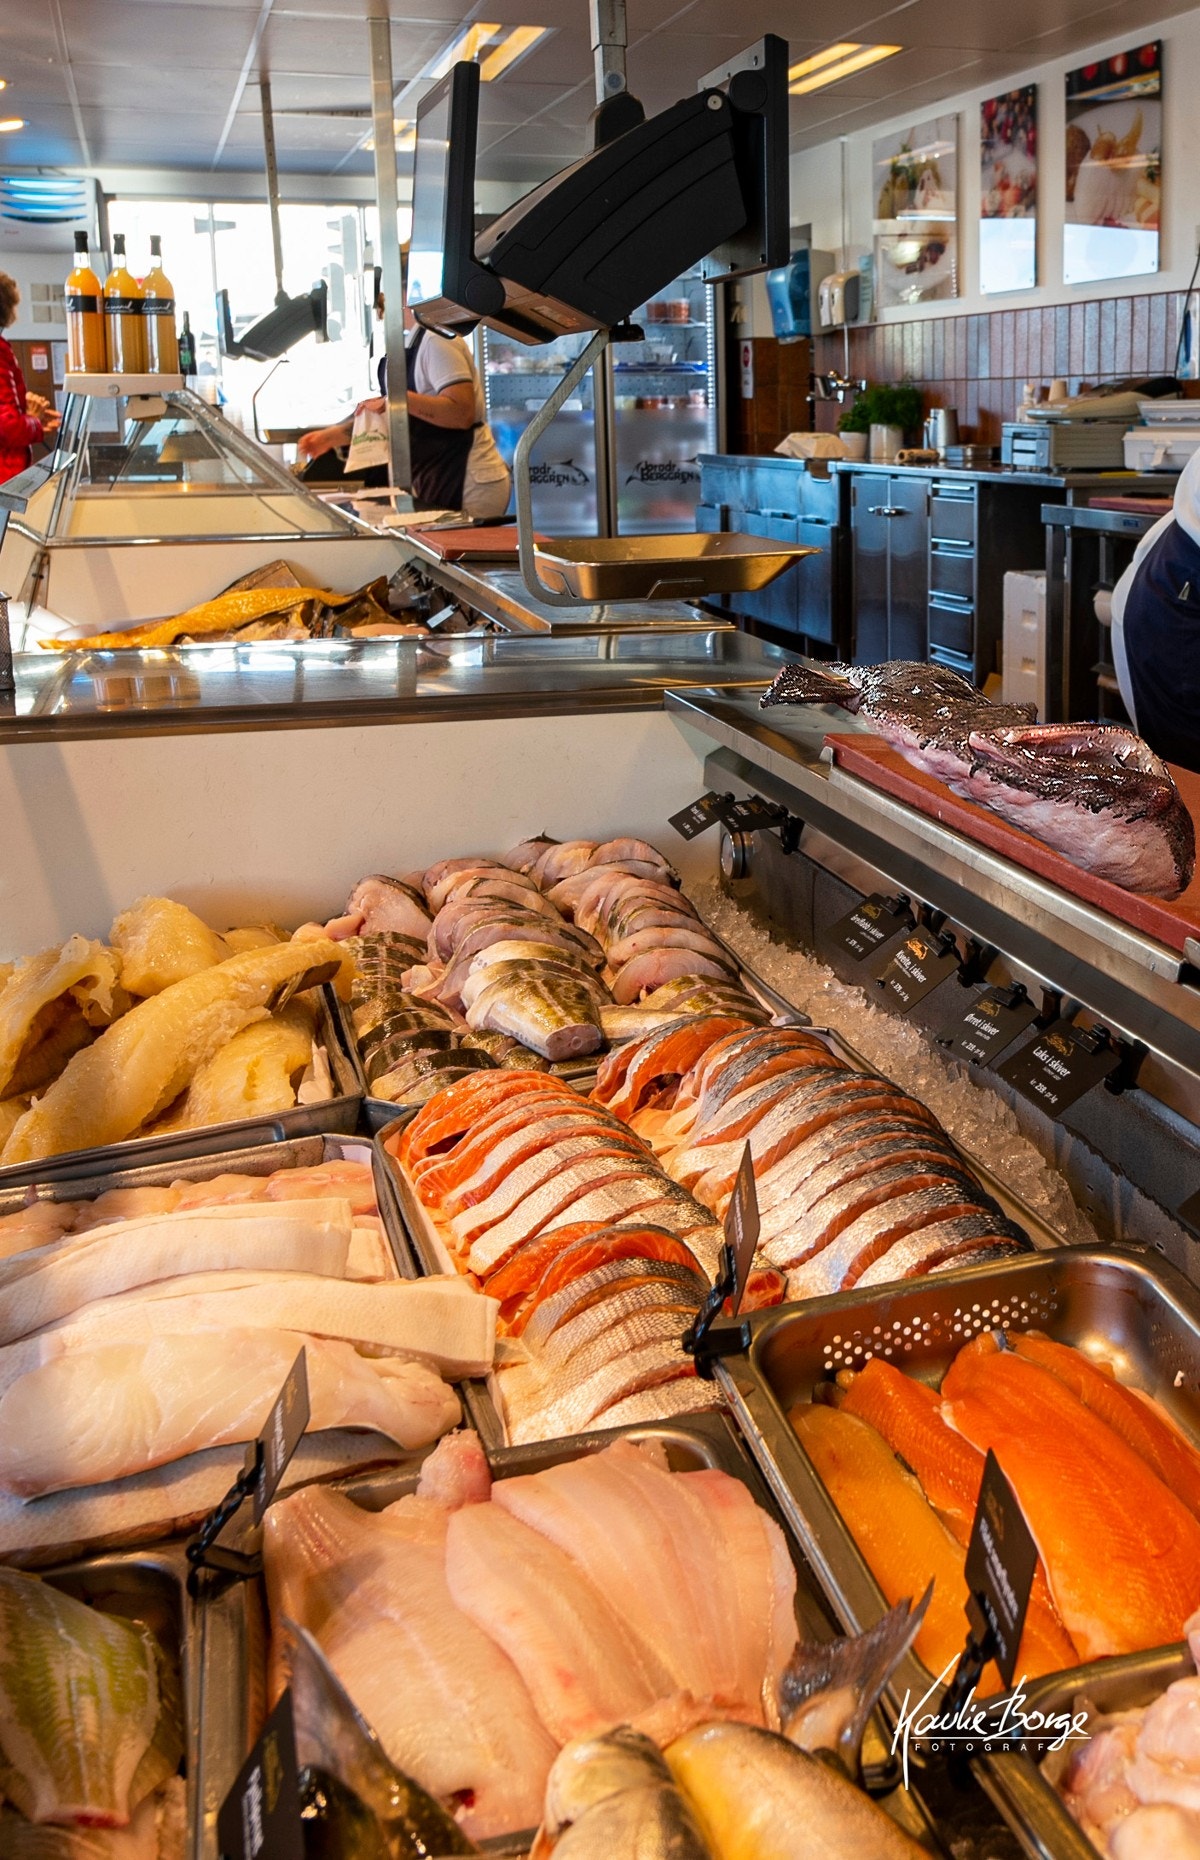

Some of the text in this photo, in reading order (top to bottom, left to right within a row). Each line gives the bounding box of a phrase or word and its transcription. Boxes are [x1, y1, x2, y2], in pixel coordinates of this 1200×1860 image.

[529, 473, 570, 485] RGGREN
[911, 967, 927, 984] skiver
[963, 1013, 982, 1027] Ørret
[980, 1022, 1000, 1036] skiver
[1032, 1046, 1050, 1061] Laks
[1048, 1060, 1071, 1077] skiver
